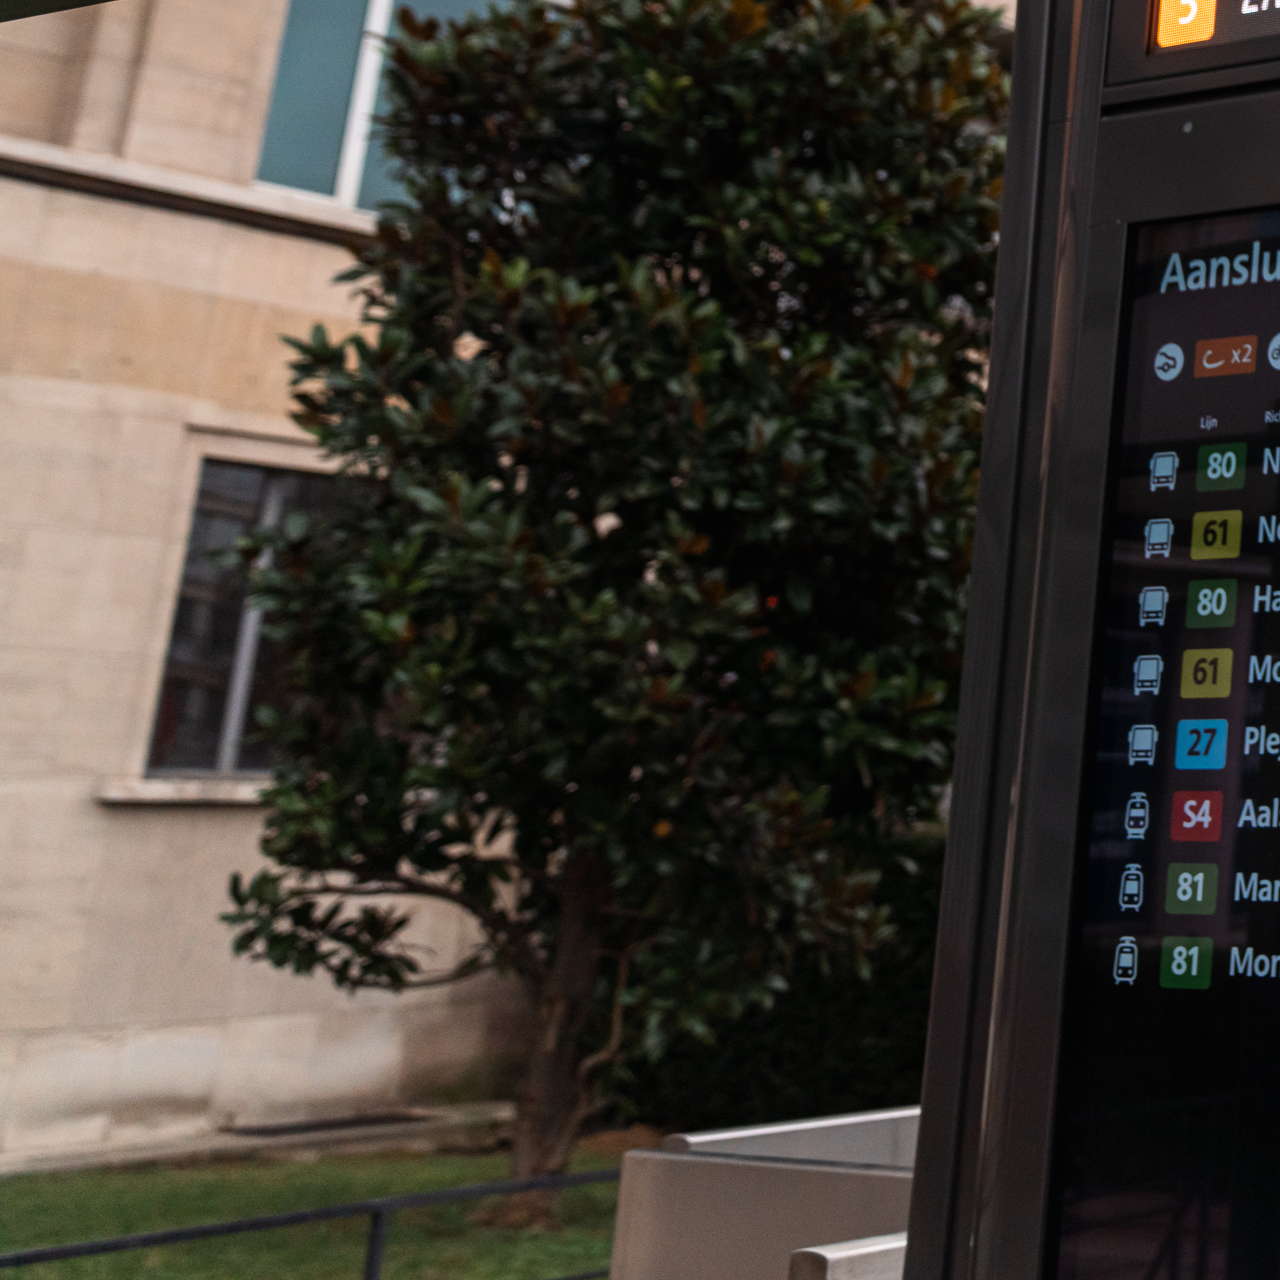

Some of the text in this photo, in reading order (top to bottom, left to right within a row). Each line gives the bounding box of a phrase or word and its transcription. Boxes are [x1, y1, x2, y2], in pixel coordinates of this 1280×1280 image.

[1199, 415, 1218, 430] Lijn
[1207, 452, 1236, 479] 80
[1203, 520, 1228, 546] 61
[1197, 588, 1227, 615] 80
[1193, 658, 1218, 685] 61
[1187, 728, 1216, 756] 27
[1183, 800, 1211, 828] S4
[1177, 873, 1204, 901] 81
[1172, 946, 1198, 975] 81
